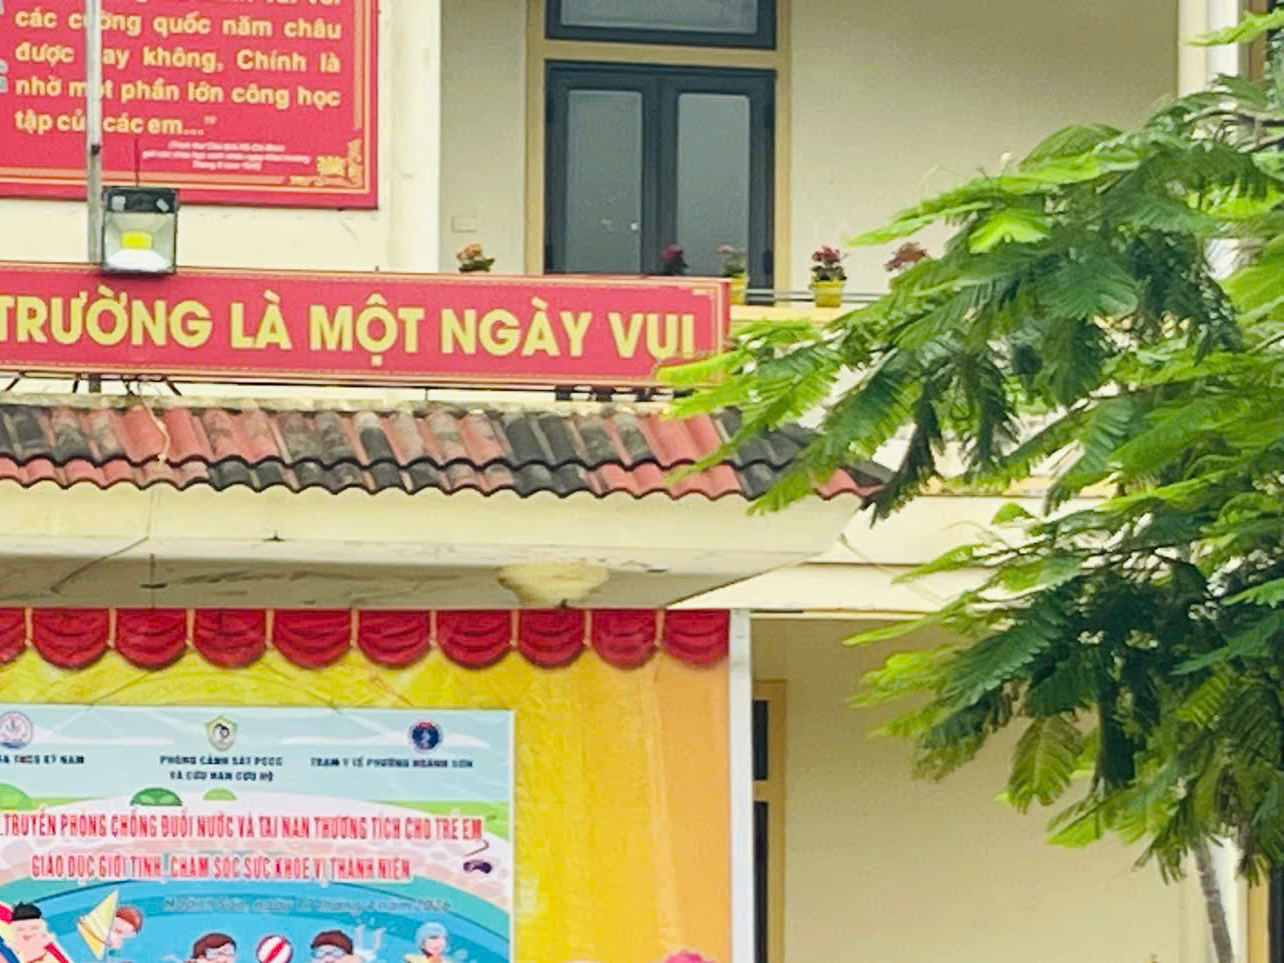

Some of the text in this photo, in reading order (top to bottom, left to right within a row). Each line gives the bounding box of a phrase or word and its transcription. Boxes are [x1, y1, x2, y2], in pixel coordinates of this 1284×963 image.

[15, 8, 342, 39] các cờng quốc năm châu
[15, 42, 75, 66] được
[96, 49, 130, 69] ay
[237, 49, 307, 72] Chính
[320, 52, 341, 73] là
[16, 75, 62, 96] nhờ
[232, 83, 290, 109] công
[297, 86, 341, 110] học
[15, 108, 53, 135] tập
[57, 108, 89, 131] củ
[103, 112, 144, 133] các
[230, 289, 292, 350] LÀ
[310, 292, 425, 366] MỘT
[441, 296, 593, 359] NGÀY
[609, 311, 695, 359] VUI
[4, 807, 56, 836] TRUYỀN
[61, 808, 106, 837] PHÒNG
[111, 806, 157, 837] CHỐNG
[238, 810, 255, 838] VÀ
[259, 816, 277, 838] TAI
[405, 817, 431, 839] CHO
[463, 818, 483, 840] EM
[32, 851, 64, 877] GIÁO
